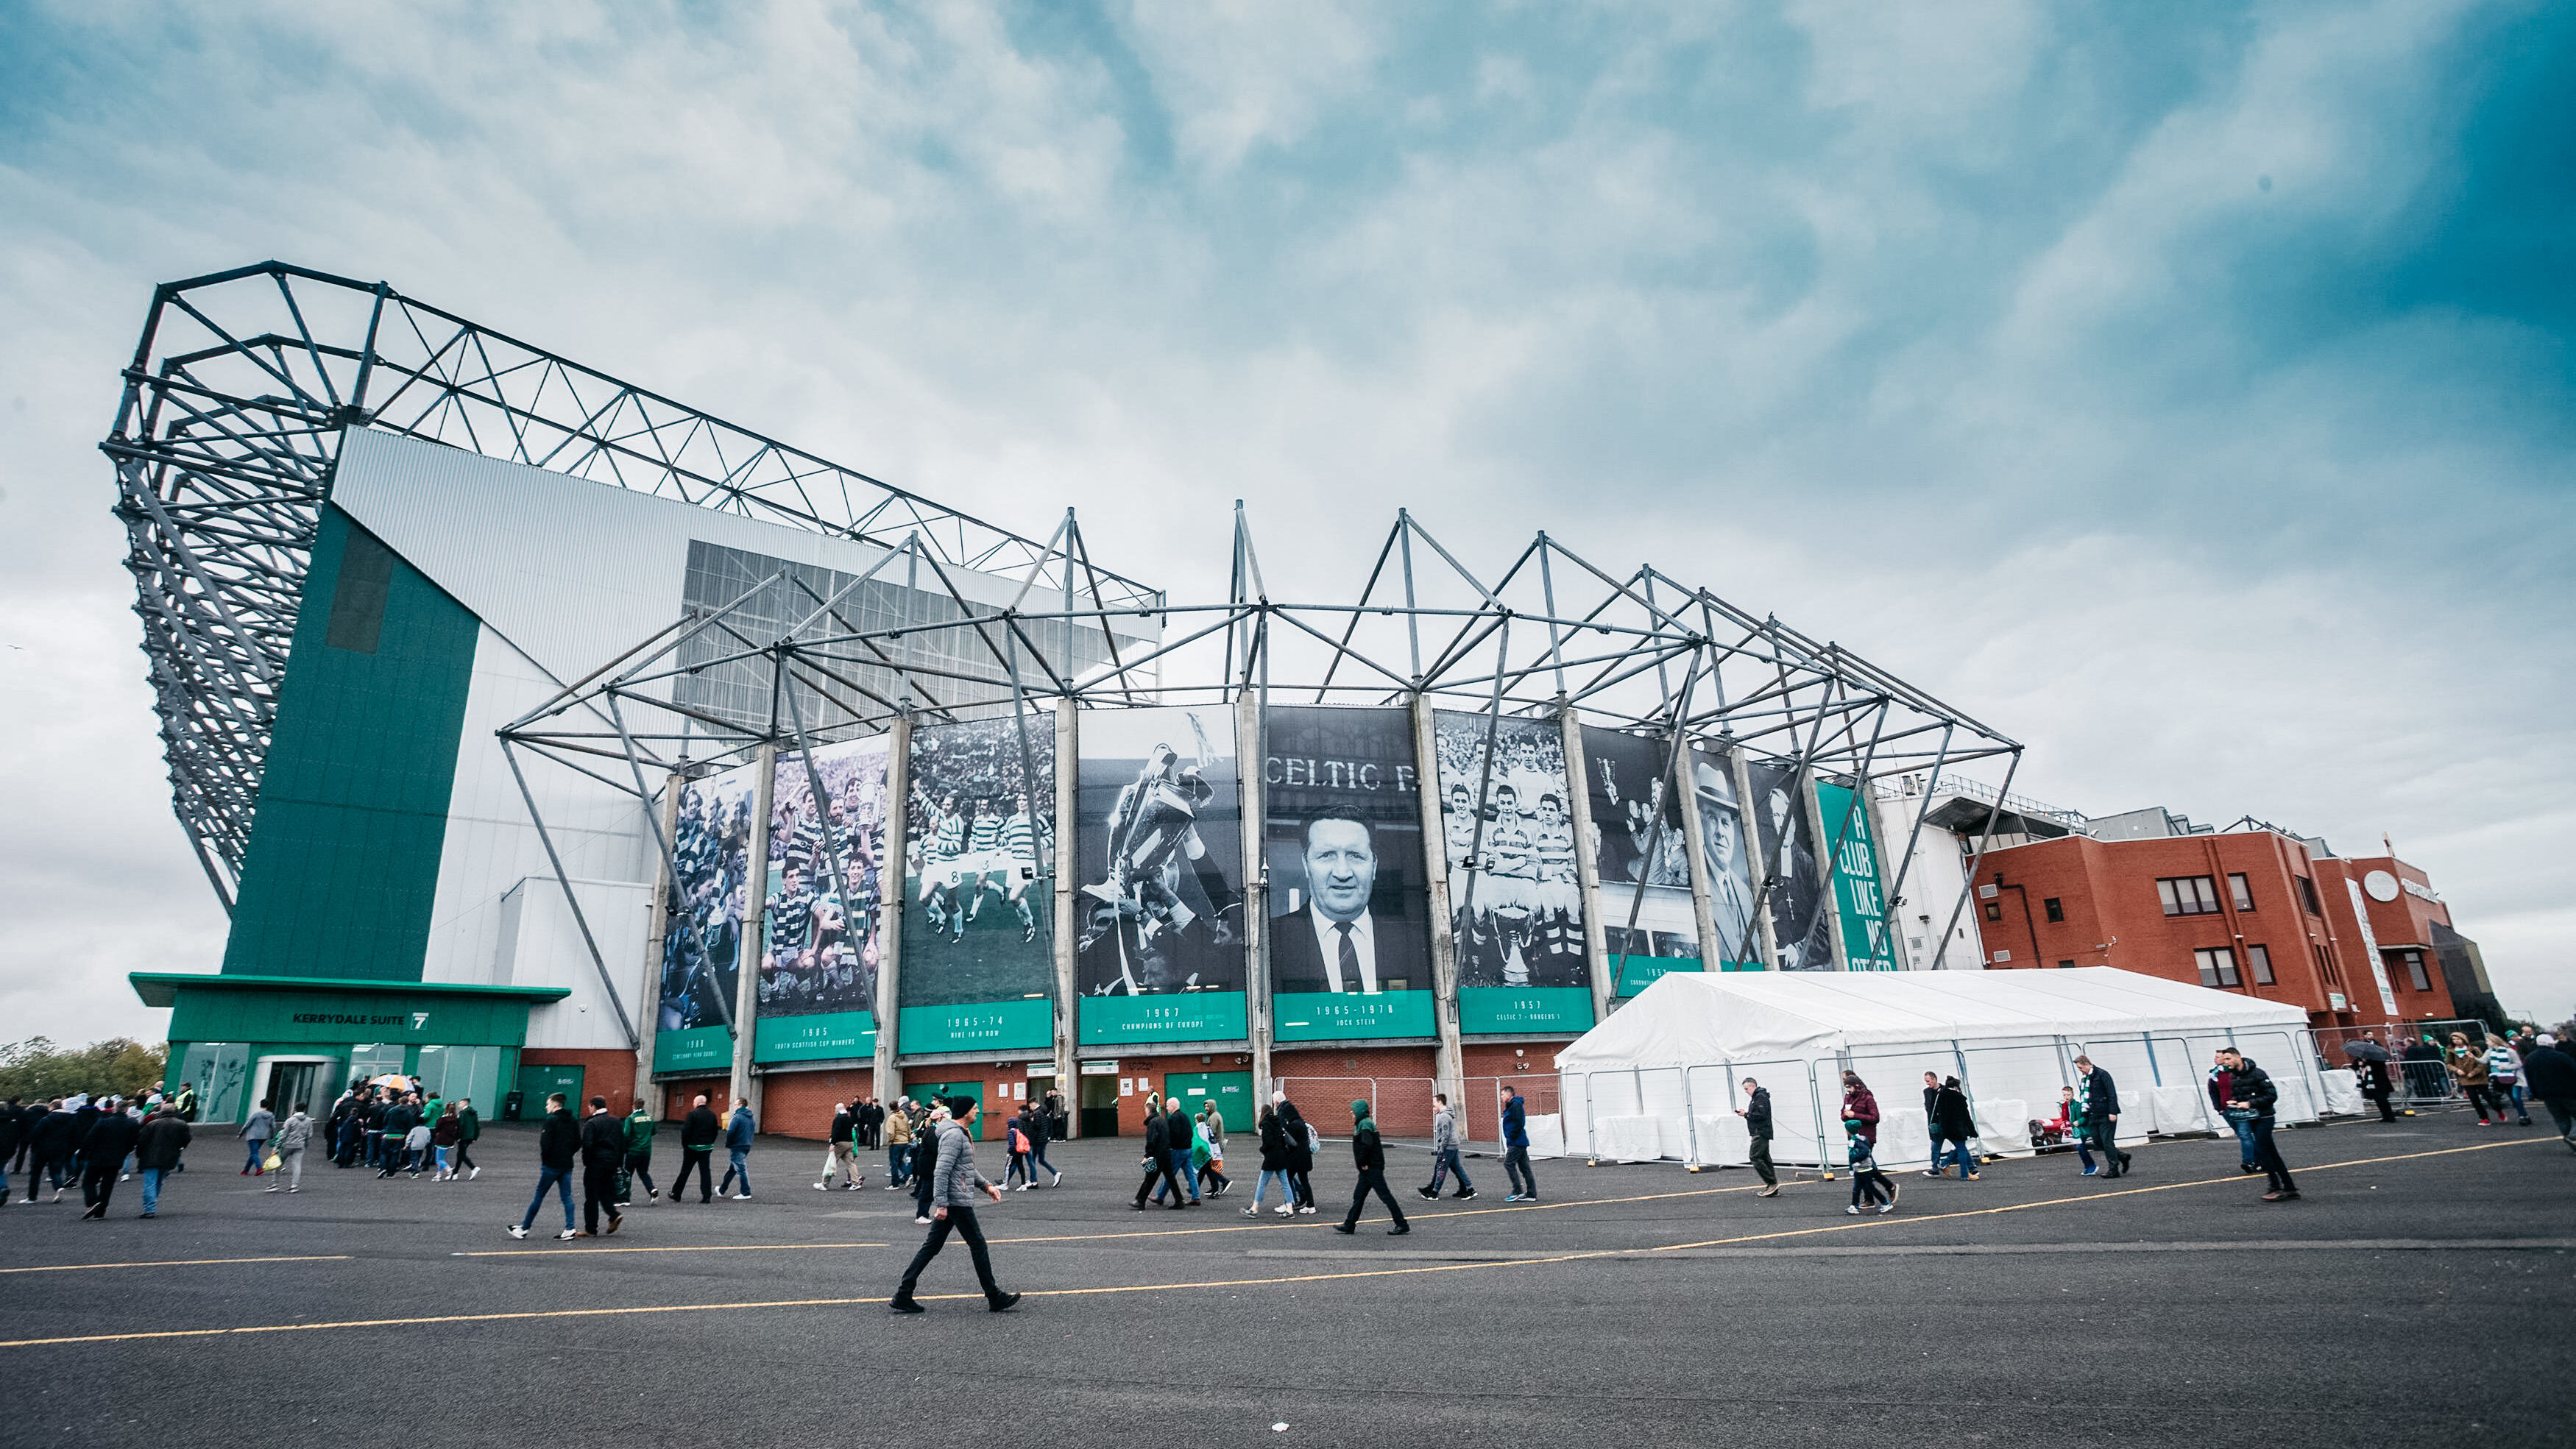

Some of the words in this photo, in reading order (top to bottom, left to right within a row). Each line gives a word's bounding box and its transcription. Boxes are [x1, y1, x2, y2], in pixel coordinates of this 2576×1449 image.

[1267, 757, 1380, 790] CELTIC
[1853, 805, 1866, 840] A
[1836, 838, 1873, 877] CLUB
[952, 871, 959, 883] 8
[1850, 878, 1881, 916] LIKE
[1865, 919, 1889, 956] NO
[1147, 1008, 1179, 1018] 1967
[1514, 1001, 1540, 1009] 1957
[293, 1013, 367, 1024] KERRYDALE
[369, 1015, 406, 1025] SUITE
[414, 1016, 426, 1030] 7
[802, 1027, 827, 1036] 1985
